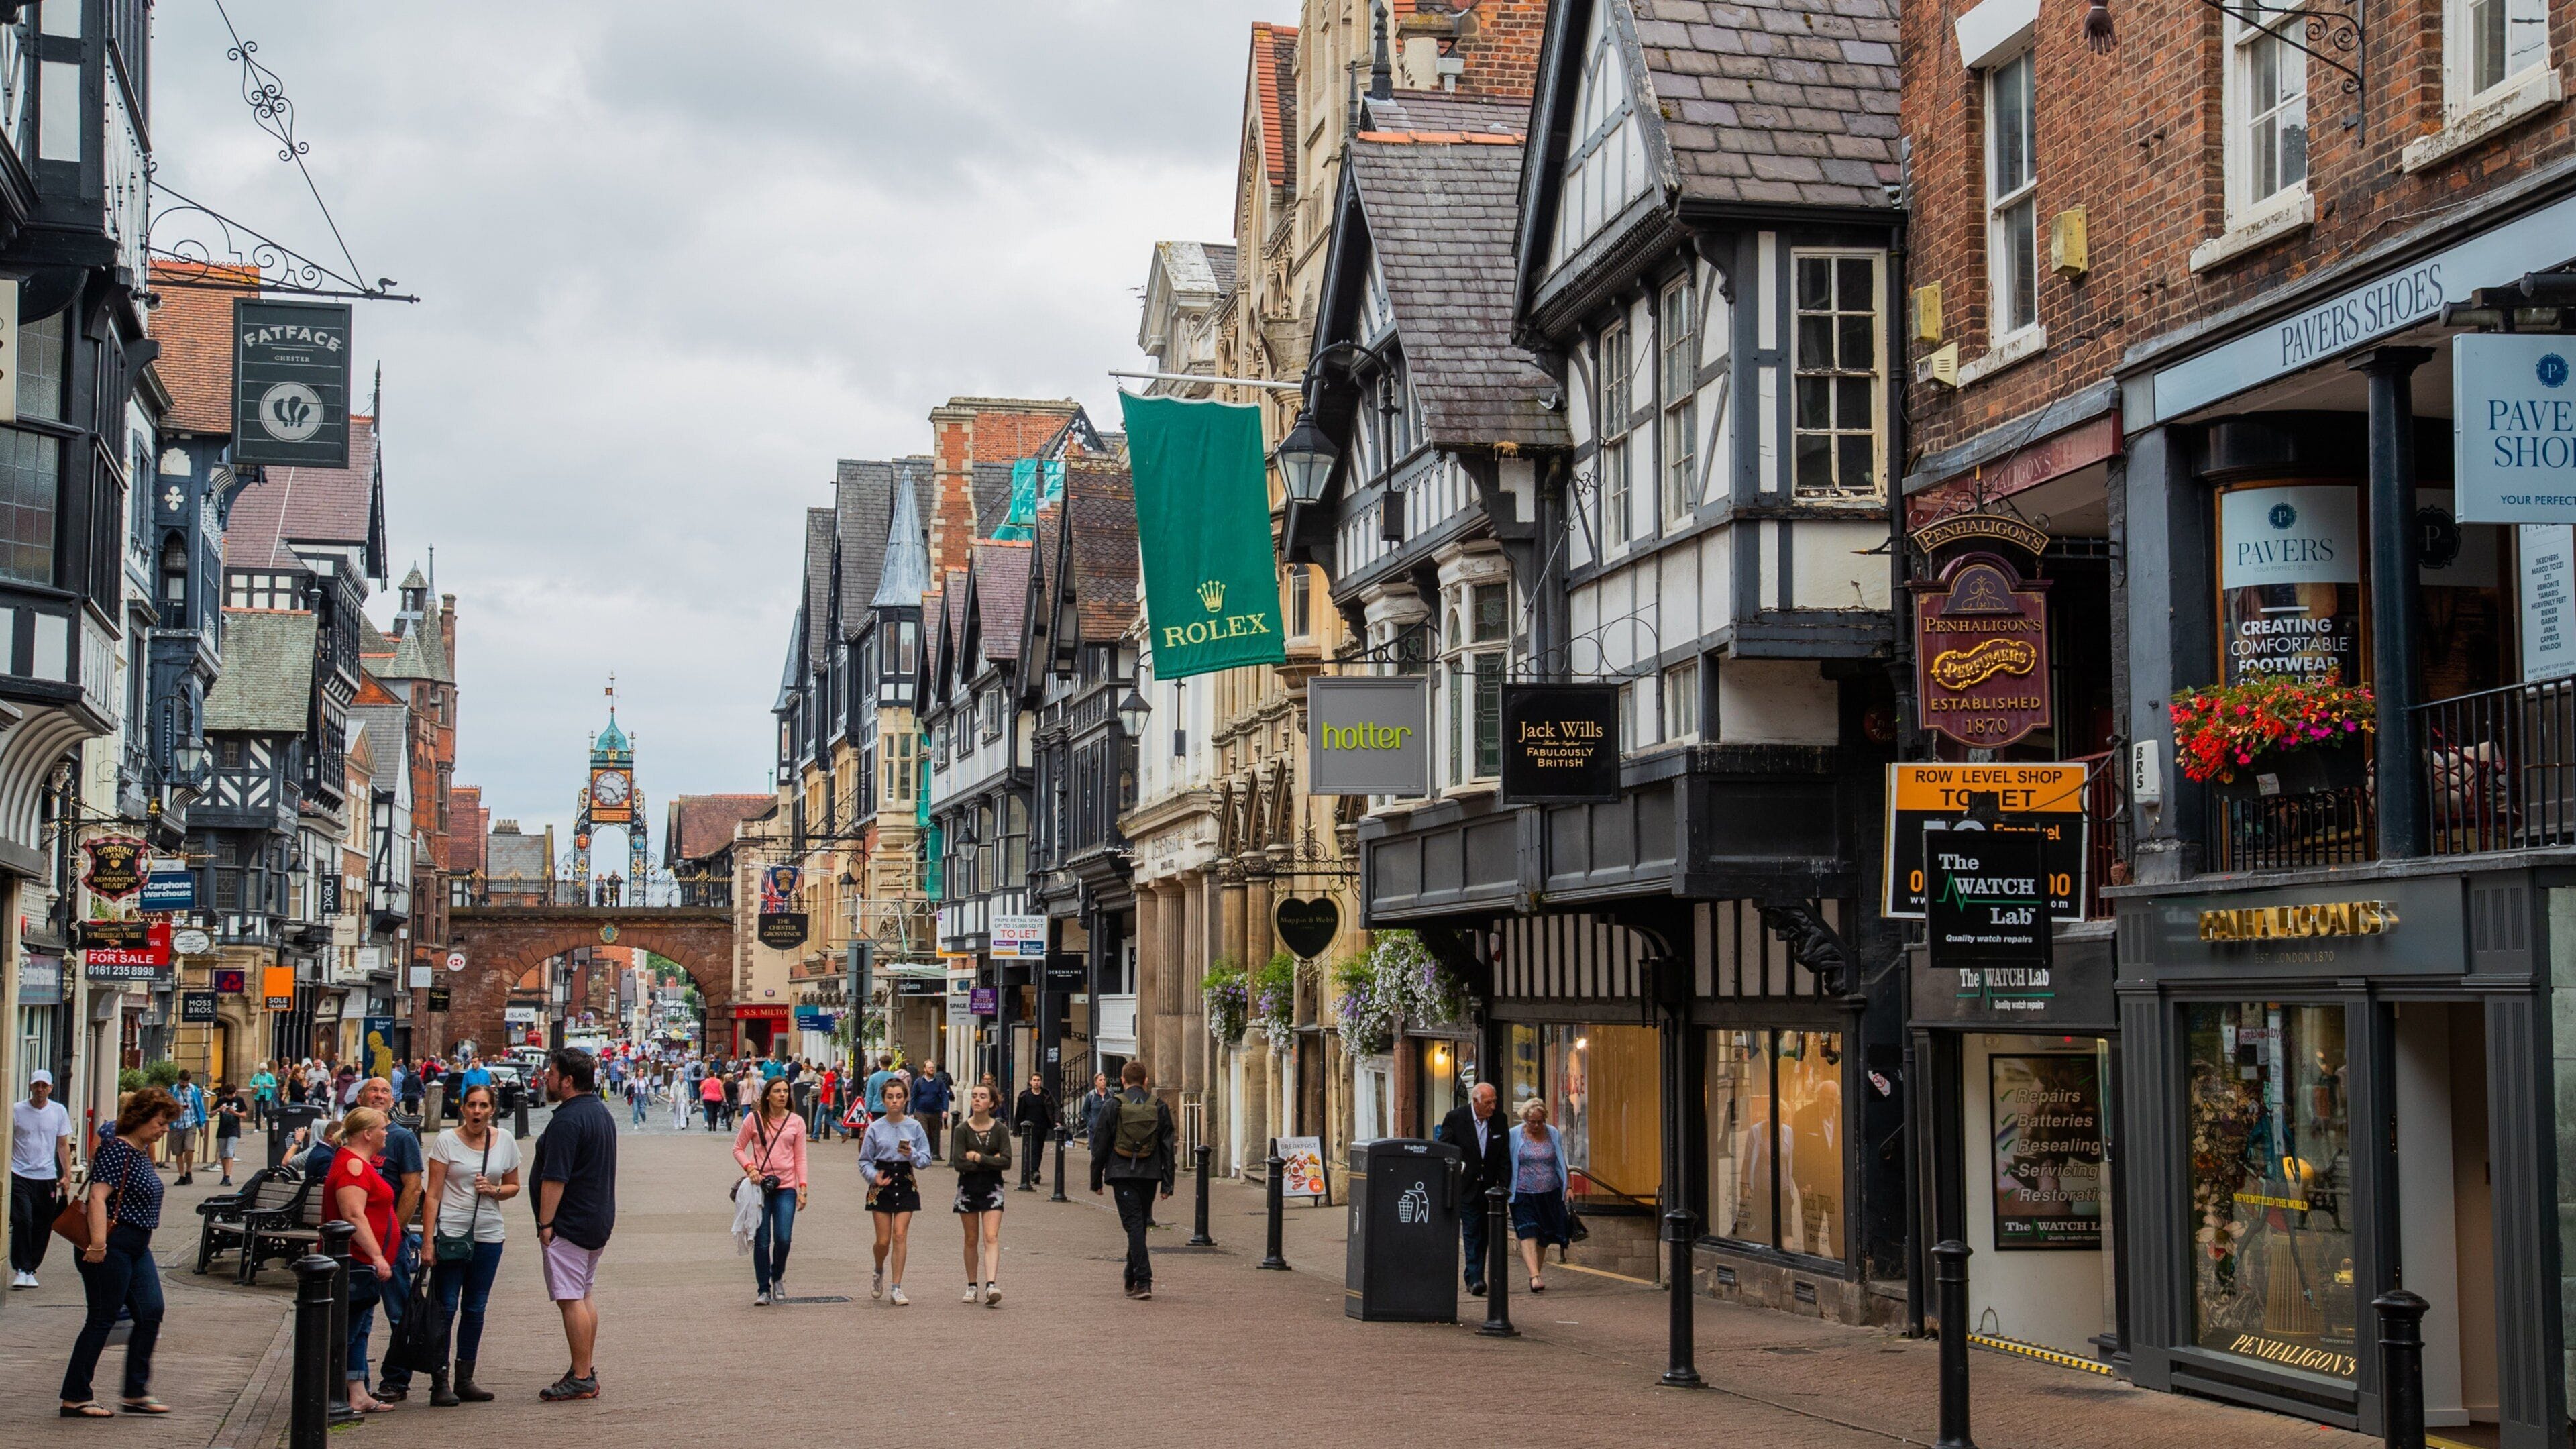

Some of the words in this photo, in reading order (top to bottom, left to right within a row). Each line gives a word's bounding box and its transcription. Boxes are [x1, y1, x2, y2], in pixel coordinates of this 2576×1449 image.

[2281, 299, 2359, 366] PAVERS
[2365, 264, 2443, 333] SHOES
[244, 325, 341, 352] FATFACE
[2501, 496, 2531, 505] YOUR
[1920, 520, 2043, 549] PENHALIGON'S
[2239, 538, 2334, 566] PAVERS
[2536, 553, 2559, 565] SKECHERS
[2531, 566, 2548, 575] MARCO
[2549, 561, 2564, 572] TOZZI
[2537, 580, 2559, 591] REMONTE
[2538, 590, 2559, 600] TAMARIS
[2531, 600, 2555, 610] HEAVENLY
[2556, 596, 2567, 605] FEET
[2541, 607, 2557, 616] RIEKER
[1924, 617, 2042, 633] PENHALIGON'S
[2241, 618, 2332, 636] CREATING
[2541, 616, 2558, 626] GABOR
[1163, 613, 1271, 648] ROLEX
[2543, 625, 2556, 634] JANA
[2540, 633, 2560, 643] CAPRICE
[2231, 637, 2348, 656] COMFORTABLE
[2539, 642, 2561, 653] KINLOCH
[1944, 648, 2027, 678] PERFUMERS
[1931, 697, 2041, 710] ESTABLISHED
[1518, 721, 1556, 743] Jack
[1560, 721, 1603, 737] Wills
[1966, 718, 2008, 733] 1870
[1322, 721, 1412, 749] hotter
[1527, 747, 1594, 757] FABULOUSLY
[1538, 758, 1584, 767] BRITISH
[1915, 770, 1953, 783] ROW
[1962, 771, 2012, 784] LEVEL
[2017, 771, 2062, 784] SHOP
[97, 845, 134, 857] GODSTALL
[1939, 854, 1979, 870] The
[147, 881, 191, 890] Carphone
[1955, 878, 2035, 895] WATCH
[144, 890, 191, 898] Warehouse
[323, 879, 334, 910] next
[1000, 930, 1016, 938] TO
[1019, 930, 1038, 938] LET
[1946, 934, 1975, 943] Quality
[1977, 934, 2001, 943] watch
[2004, 935, 2033, 944] repairs
[89, 953, 116, 963] FOR
[119, 955, 154, 964] SALE
[2275, 951, 2310, 963] LONDON
[2314, 951, 2334, 963] 1870
[88, 965, 110, 975] 0161
[113, 966, 130, 975] 235
[131, 967, 154, 976] 8998
[1960, 969, 1979, 987] The
[1984, 968, 2025, 987] WATCH
[2028, 968, 2049, 987] Lab
[1994, 1000, 2010, 1011] Quality
[2012, 1000, 2026, 1009] watch
[2027, 1000, 2045, 1011] repairs
[2016, 1088, 2081, 1106] Repairs
[2017, 1113, 2093, 1128] Batteries
[2017, 1138, 2100, 1155] Resealing
[2018, 1162, 2099, 1181] Servicing
[2233, 1193, 2250, 1203] WE'VE
[2251, 1194, 2275, 1206] BOTTLED
[2275, 1198, 2287, 1208] THE
[2288, 1199, 2308, 1211] WORLD
[2005, 1222, 2031, 1232] The
[2037, 1222, 2087, 1231] WATCH
[2229, 1334, 2357, 1375] PENHALIGON'S
